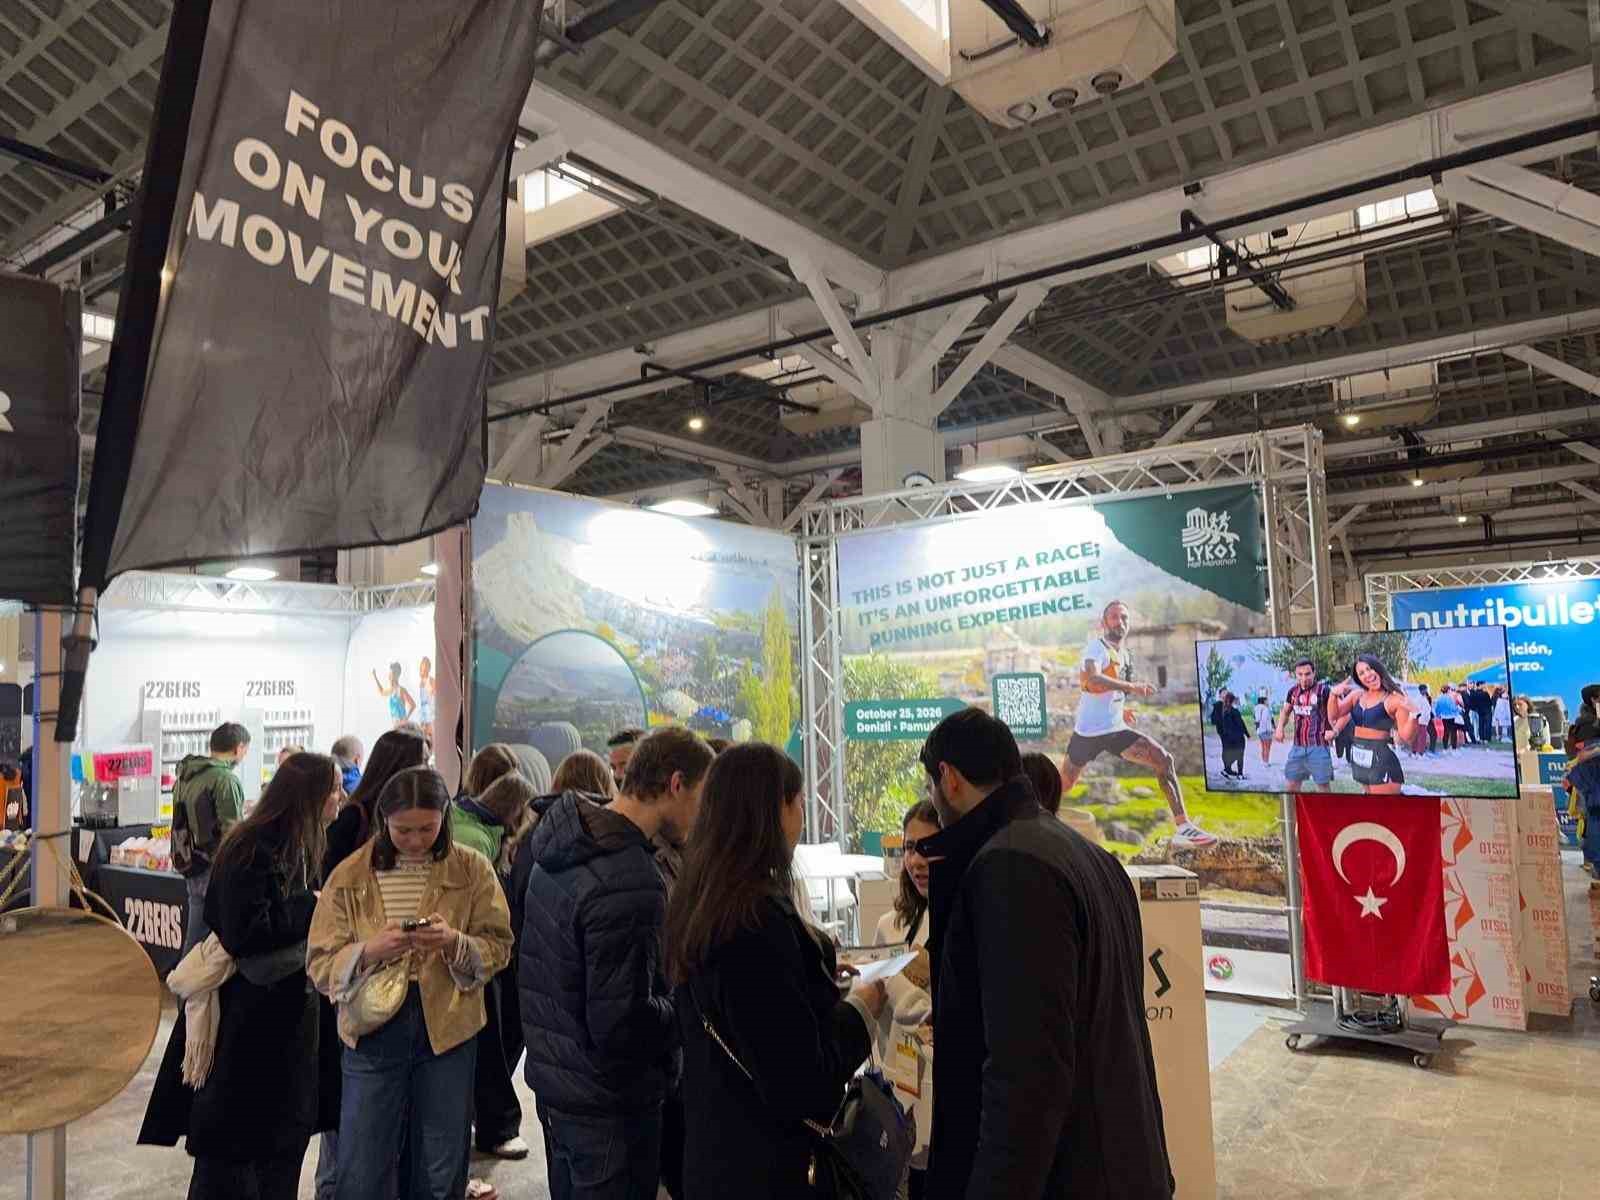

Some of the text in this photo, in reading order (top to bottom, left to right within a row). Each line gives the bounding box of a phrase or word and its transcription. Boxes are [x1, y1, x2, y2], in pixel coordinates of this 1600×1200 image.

[233, 137, 326, 220] ON
[284, 89, 474, 223] FOCUS
[186, 191, 490, 349] MOVEMENT
[852, 541, 1101, 605] THIS IS NOT JUST A RACE;
[1187, 544, 1236, 562] LYKOS
[858, 565, 1100, 626] IT'S AN UNFORGETTABLE
[869, 594, 1093, 649] RUNNING EXPERIENCE.
[145, 680, 201, 698] 226ERS
[246, 680, 295, 696] 226ERS
[856, 708, 897, 720] October
[917, 707, 942, 719] 2026
[856, 722, 891, 733] Denizli
[125, 897, 182, 950] 226ERS
